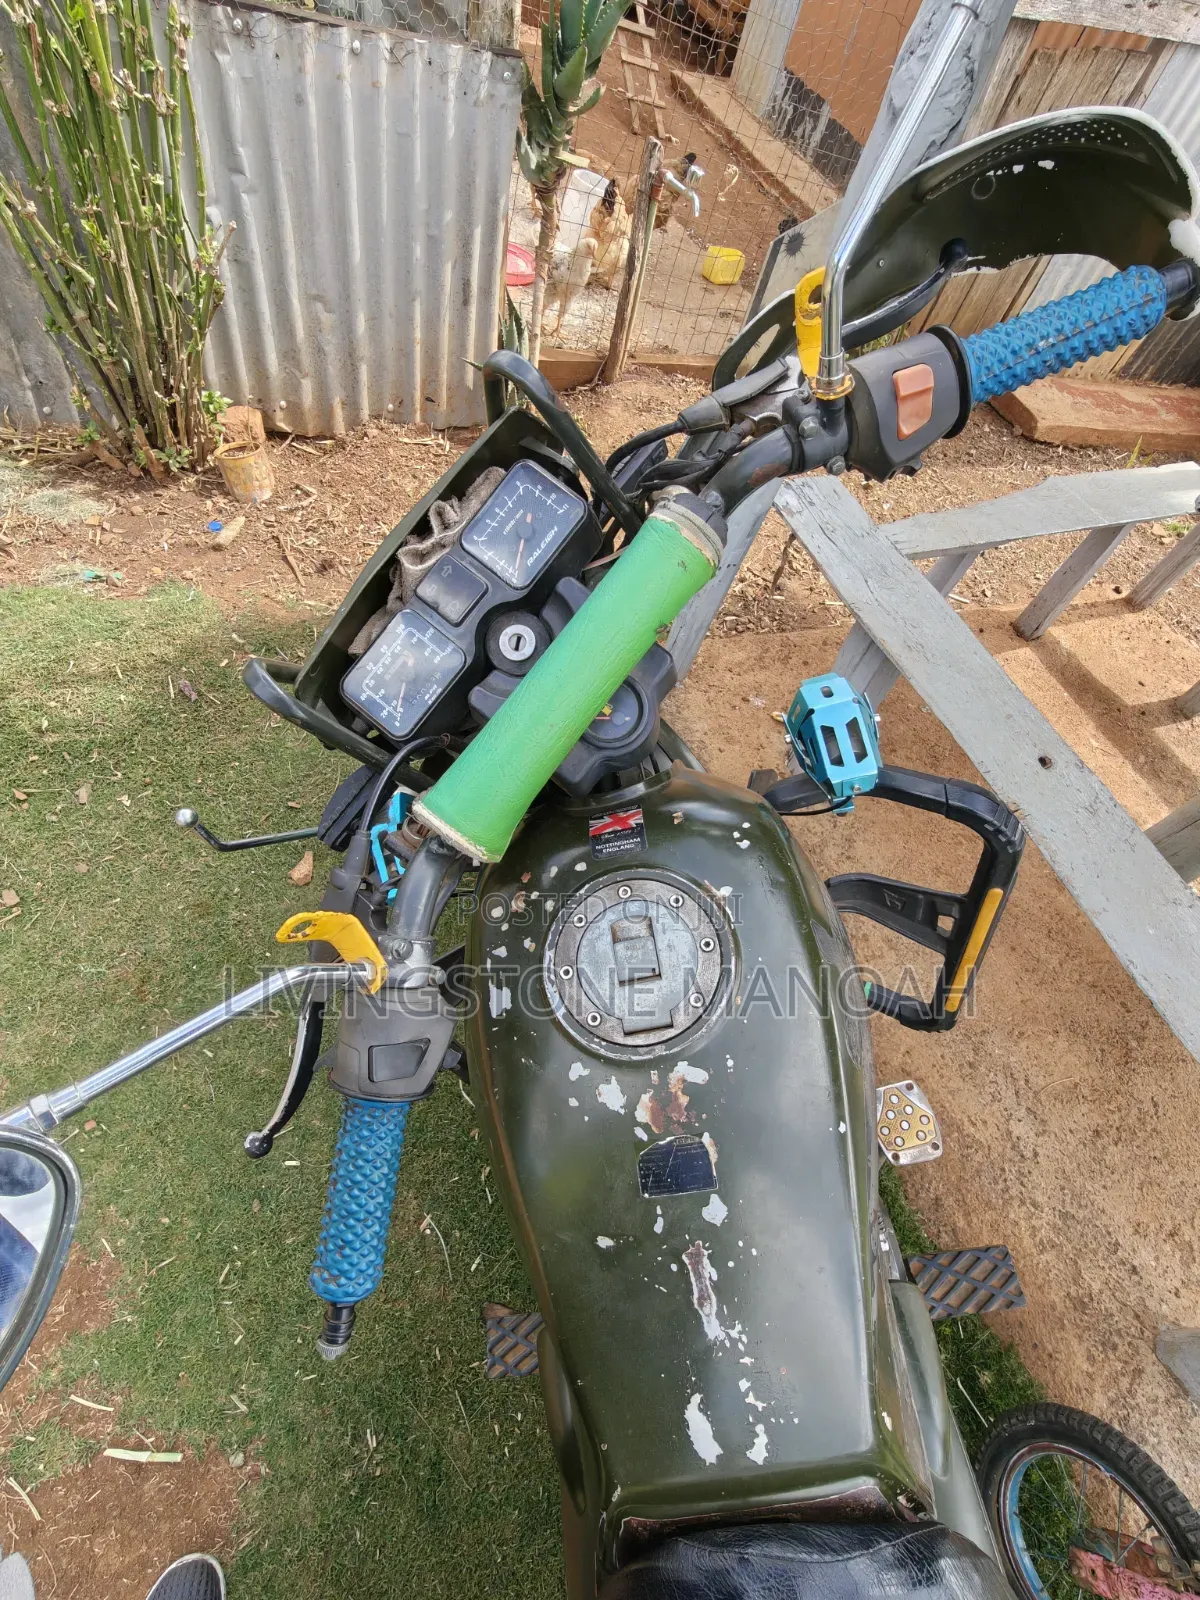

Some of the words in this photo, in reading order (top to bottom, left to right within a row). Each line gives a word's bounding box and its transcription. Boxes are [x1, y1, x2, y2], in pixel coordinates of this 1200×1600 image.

[562, 503, 570, 511] 11
[526, 525, 559, 567] RALEIGH
[595, 837, 641, 850] NOTTINGHAM
[602, 843, 635, 853] ENGLAND
